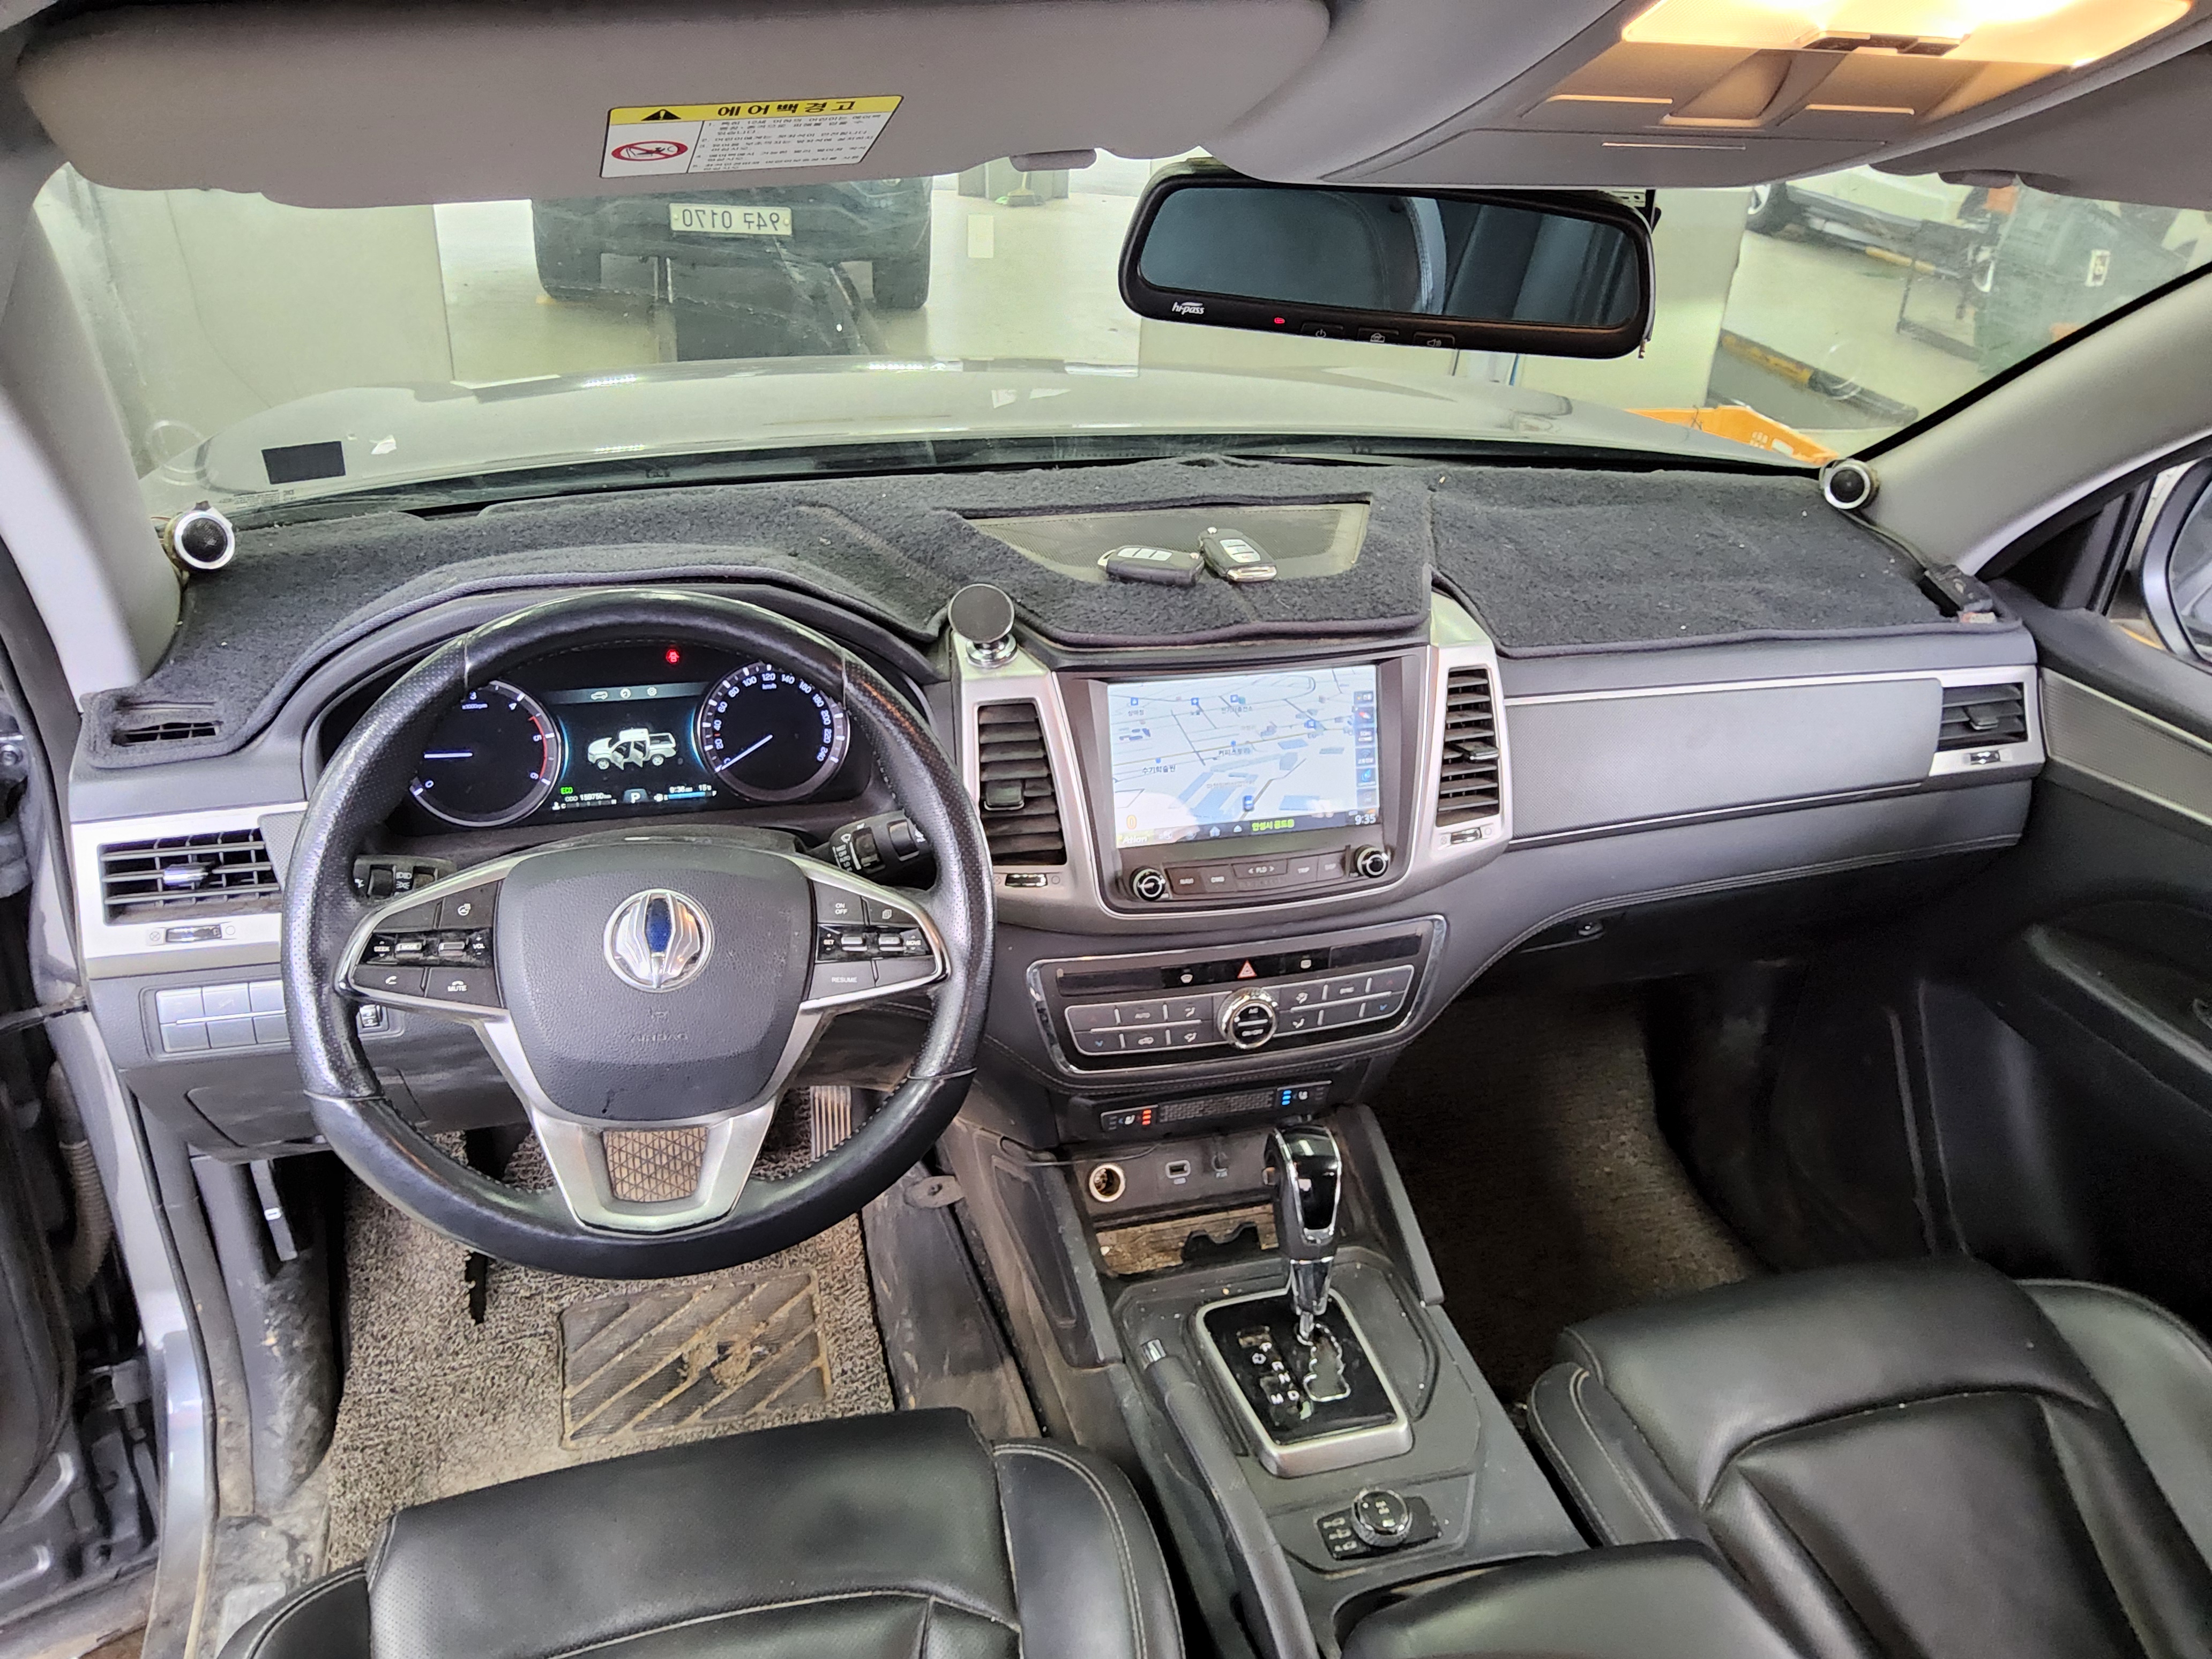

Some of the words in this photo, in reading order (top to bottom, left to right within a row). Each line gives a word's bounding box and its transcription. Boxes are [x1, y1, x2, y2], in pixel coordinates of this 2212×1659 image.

[742, 676, 757, 687] 100
[761, 673, 776, 681] 120
[781, 674, 795, 684] 140
[728, 686, 740, 698] 80
[812, 693, 825, 707] 180
[718, 701, 728, 713] 60
[821, 709, 831, 725] 200
[713, 720, 722, 731] 40
[714, 738, 723, 750] 20
[816, 746, 828, 761] 240
[630, 792, 640, 803] P
[1126, 814, 1137, 830] 0
[1355, 813, 1376, 825] 9:35
[1272, 1361, 1284, 1371] R
[1279, 1372, 1291, 1384] N
[1271, 1393, 1284, 1404] M
[1287, 1390, 1300, 1401] D
